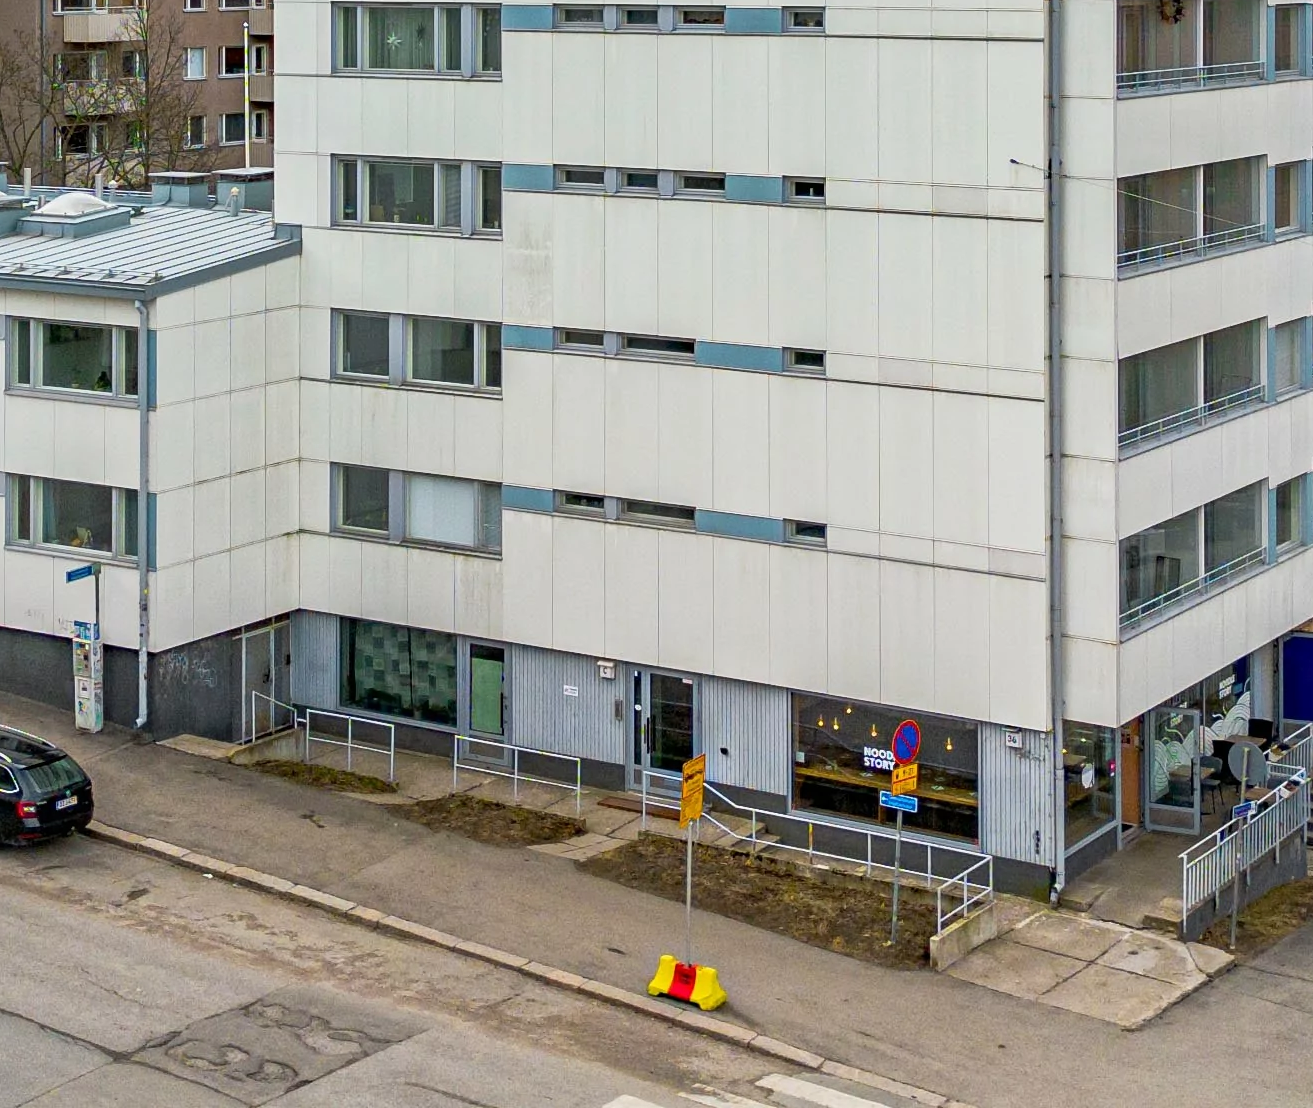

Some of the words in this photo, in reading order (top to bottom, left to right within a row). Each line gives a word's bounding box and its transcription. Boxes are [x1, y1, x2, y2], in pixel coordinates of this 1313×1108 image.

[1007, 735, 1017, 744] 36
[864, 746, 895, 761] NOOD
[864, 757, 896, 770] STORY
